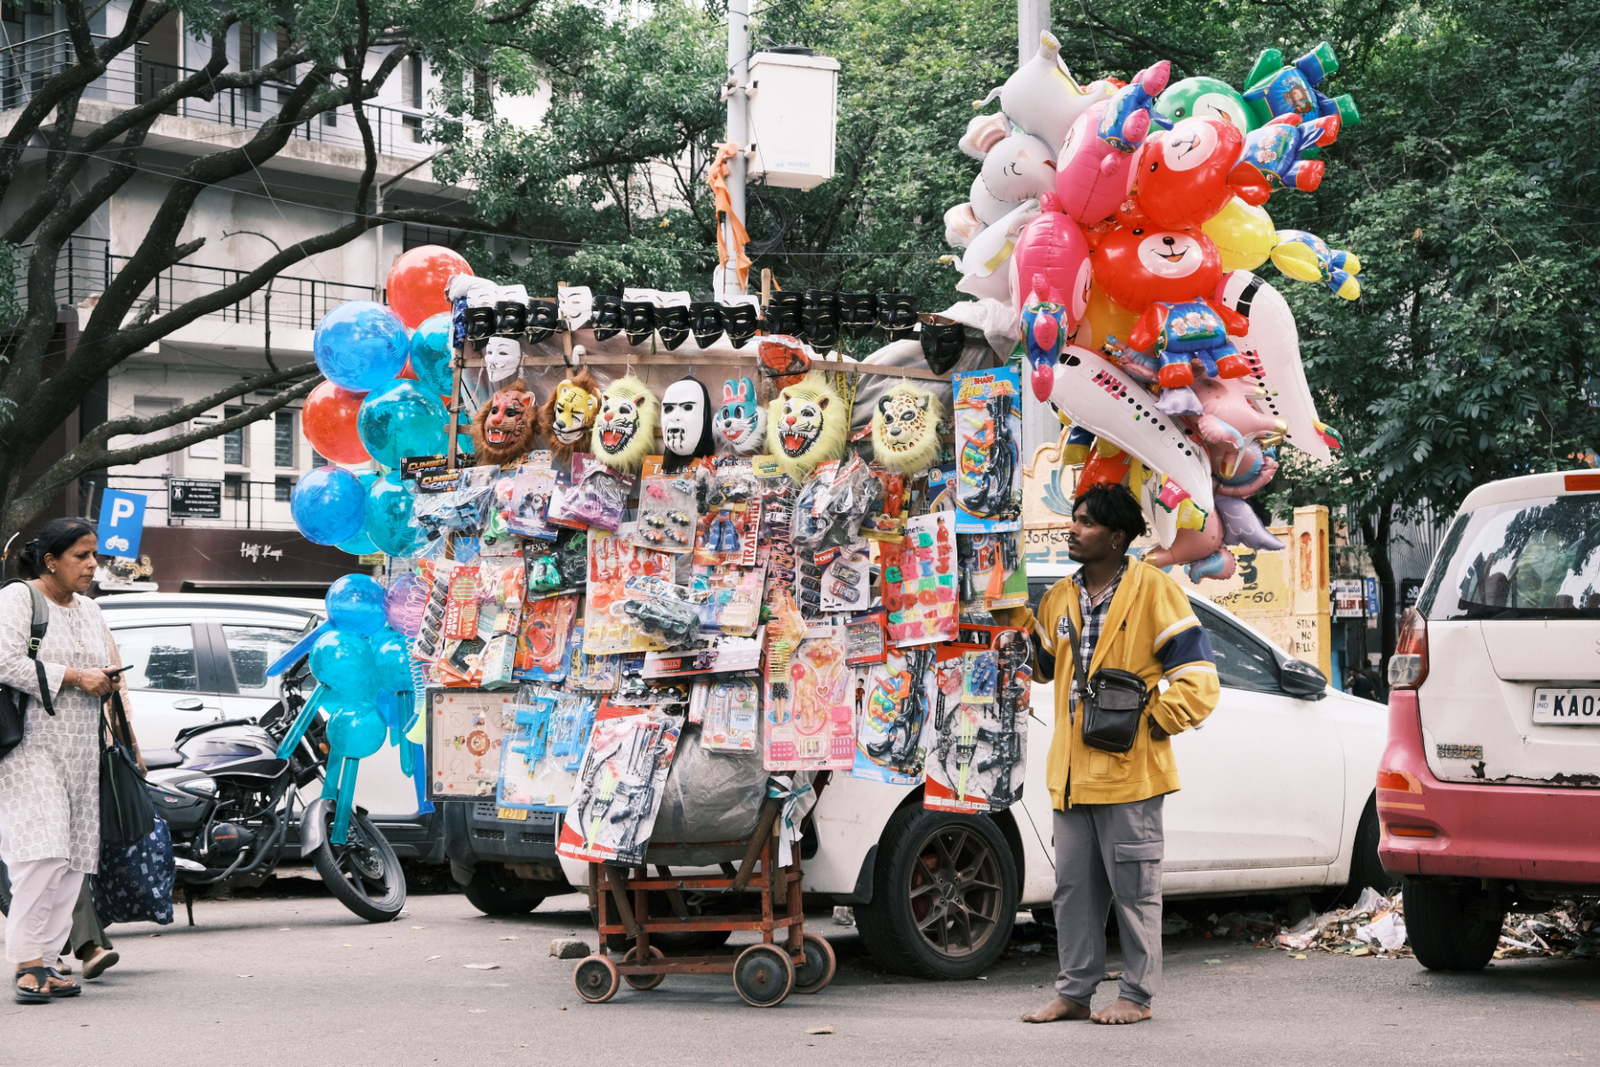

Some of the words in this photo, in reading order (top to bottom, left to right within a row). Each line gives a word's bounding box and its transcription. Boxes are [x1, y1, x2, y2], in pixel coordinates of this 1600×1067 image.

[974, 374, 995, 385] SHARP
[110, 497, 135, 527] P
[1301, 631, 1312, 640] NO
[1437, 750, 1483, 759] SUZUKI
